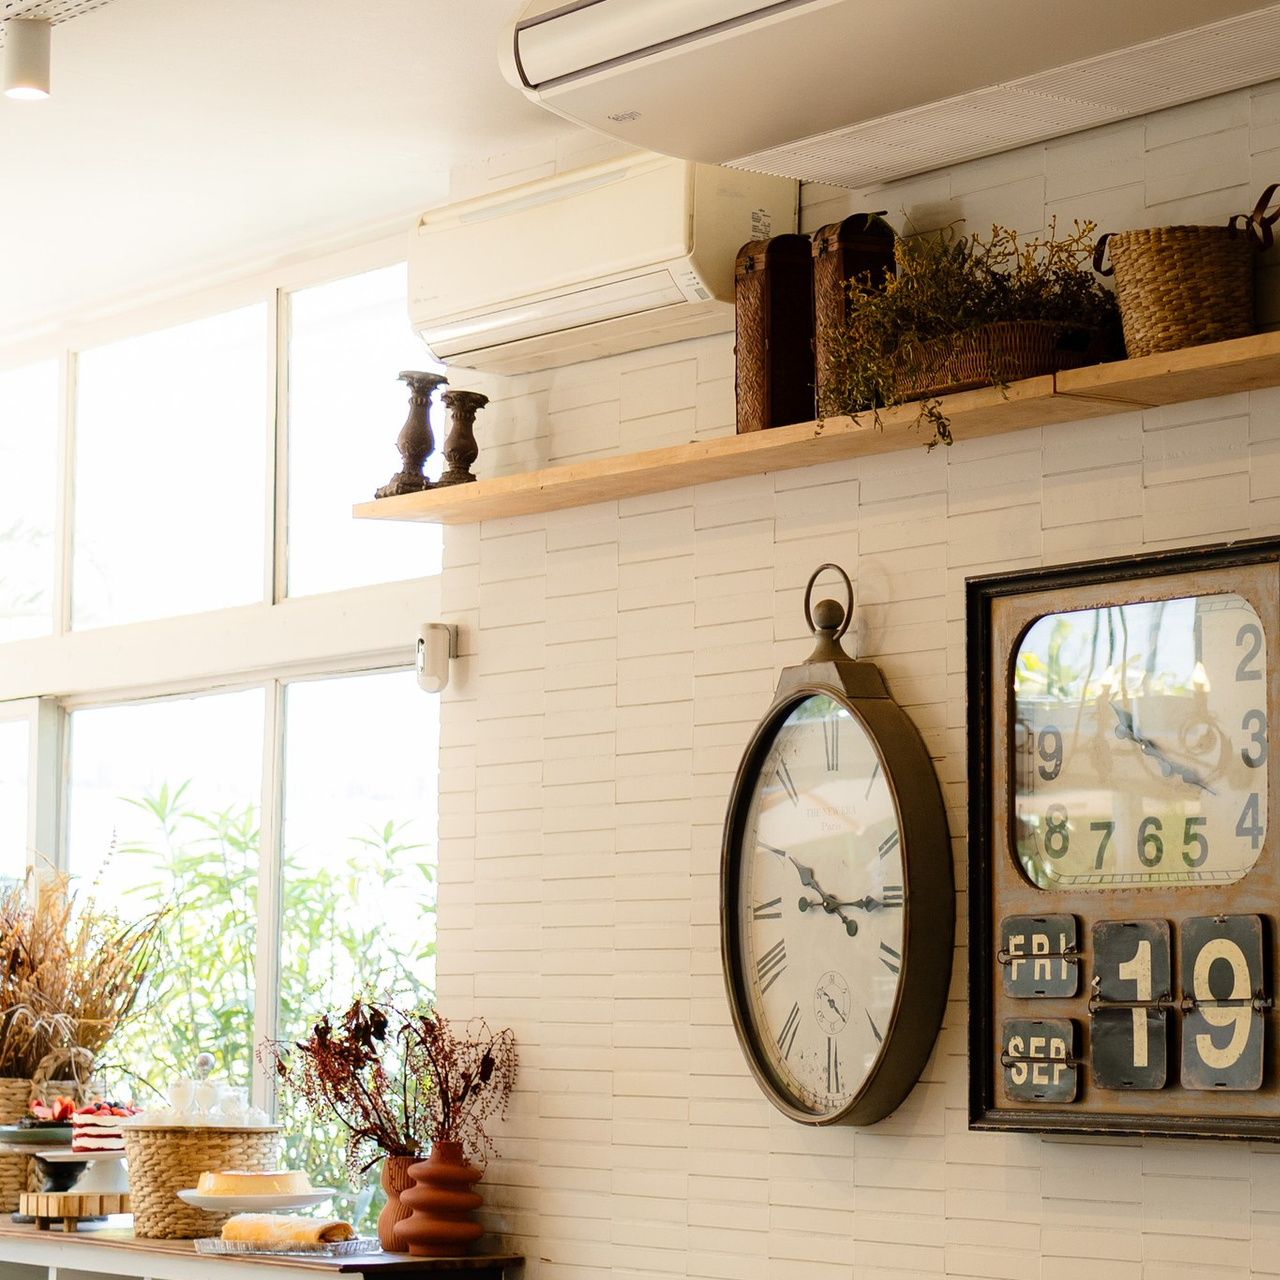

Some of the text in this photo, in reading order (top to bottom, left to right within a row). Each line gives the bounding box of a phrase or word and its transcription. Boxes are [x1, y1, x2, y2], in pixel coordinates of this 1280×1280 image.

[1235, 624, 1262, 682] 2
[1037, 725, 1062, 781] 9
[1241, 709, 1268, 768] 3
[821, 821, 842, 831] Paris
[1044, 803, 1069, 859] 8
[1090, 821, 1115, 870] 7
[1137, 816, 1163, 868] 6
[1182, 817, 1208, 868] 5
[1235, 793, 1263, 850] 4
[1009, 933, 1068, 981] FRI
[1008, 1035, 1068, 1085] SEP
